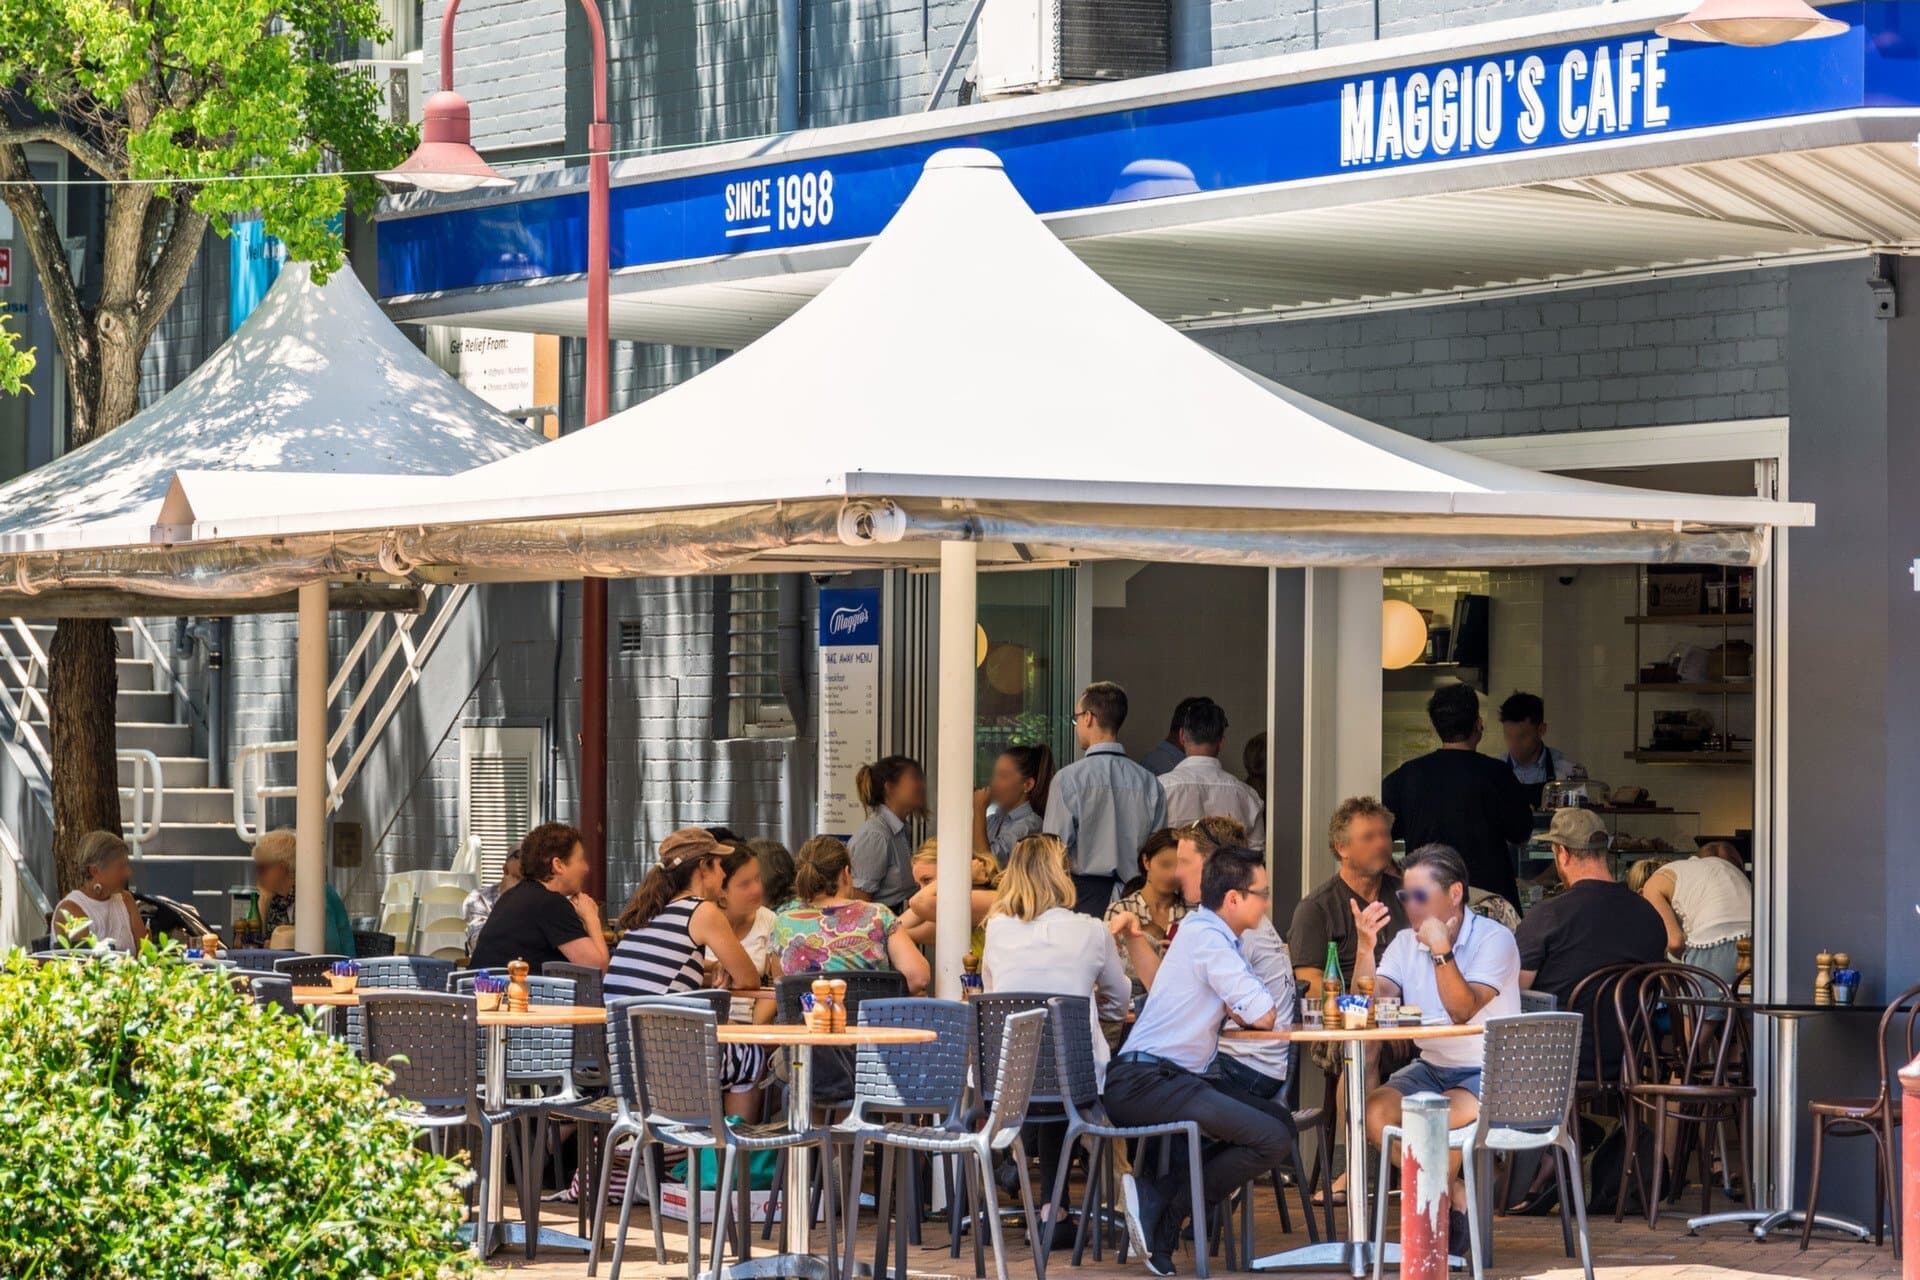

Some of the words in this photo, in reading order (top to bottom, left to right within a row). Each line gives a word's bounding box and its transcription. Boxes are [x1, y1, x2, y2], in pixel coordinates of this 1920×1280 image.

[1340, 55, 1545, 167] MAGGIO'S
[1559, 37, 1671, 139] CAFE
[725, 178, 771, 222] SINCE
[777, 170, 833, 231] 1998
[450, 340, 463, 354] Get
[465, 336, 487, 354] Relief
[487, 336, 509, 351] From:
[825, 652, 837, 665] TAKE
[839, 652, 854, 664] AWAY
[855, 652, 873, 664] MENU
